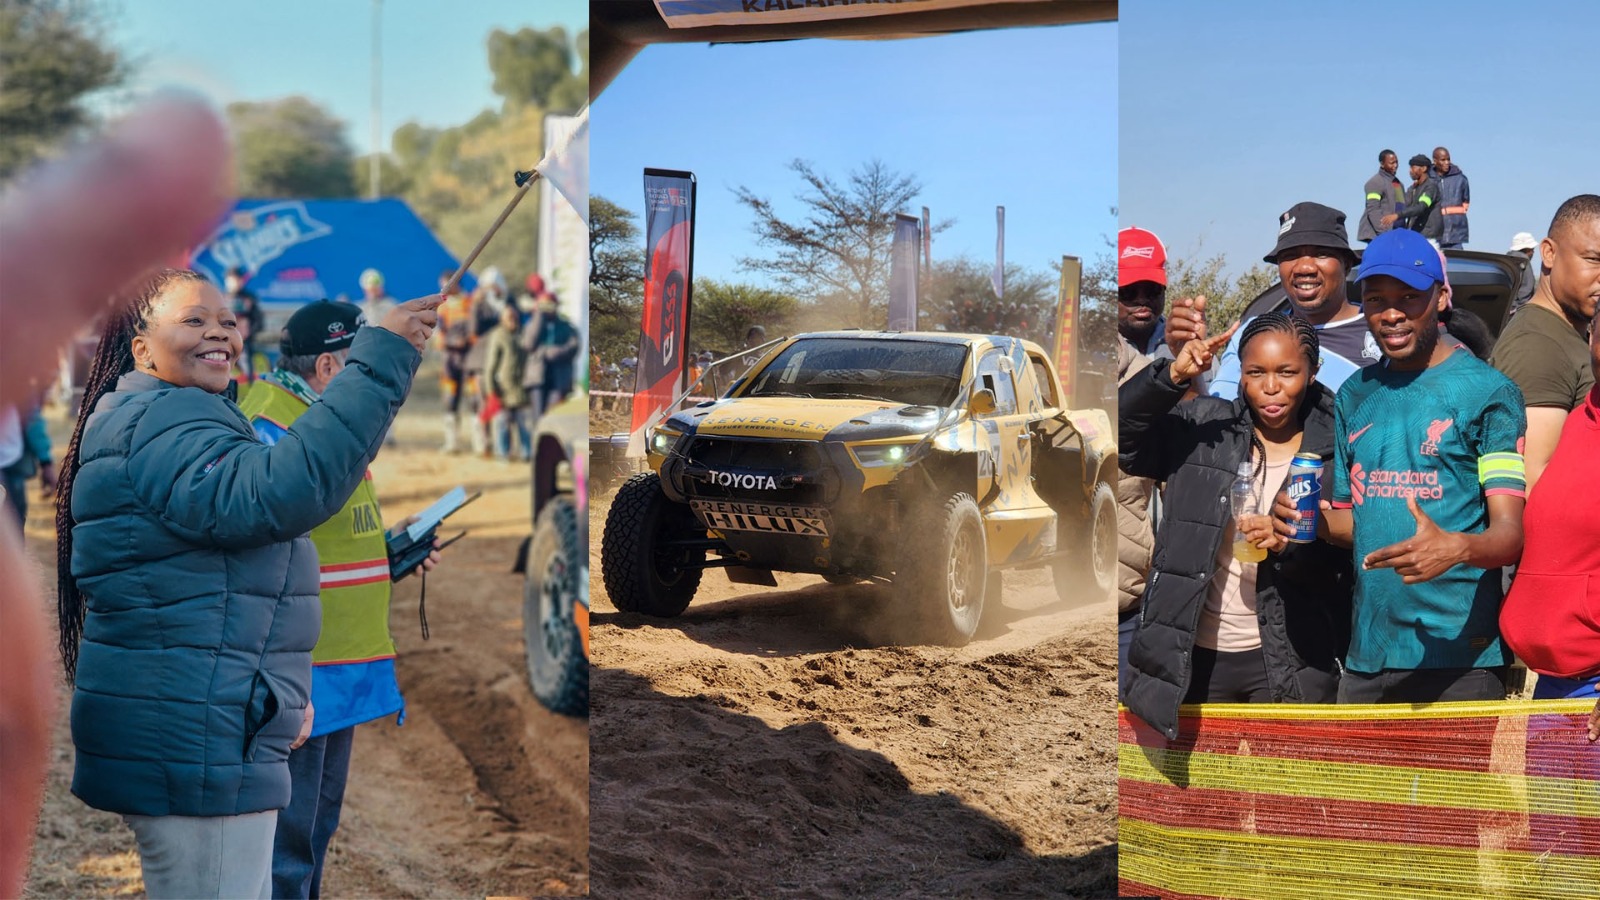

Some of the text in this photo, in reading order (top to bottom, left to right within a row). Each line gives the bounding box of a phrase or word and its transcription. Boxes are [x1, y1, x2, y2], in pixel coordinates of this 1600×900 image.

[708, 470, 777, 490] TOYOTA
[1368, 469, 1438, 485] standard
[1366, 484, 1443, 499] chartered
[705, 512, 827, 536] HILUX
